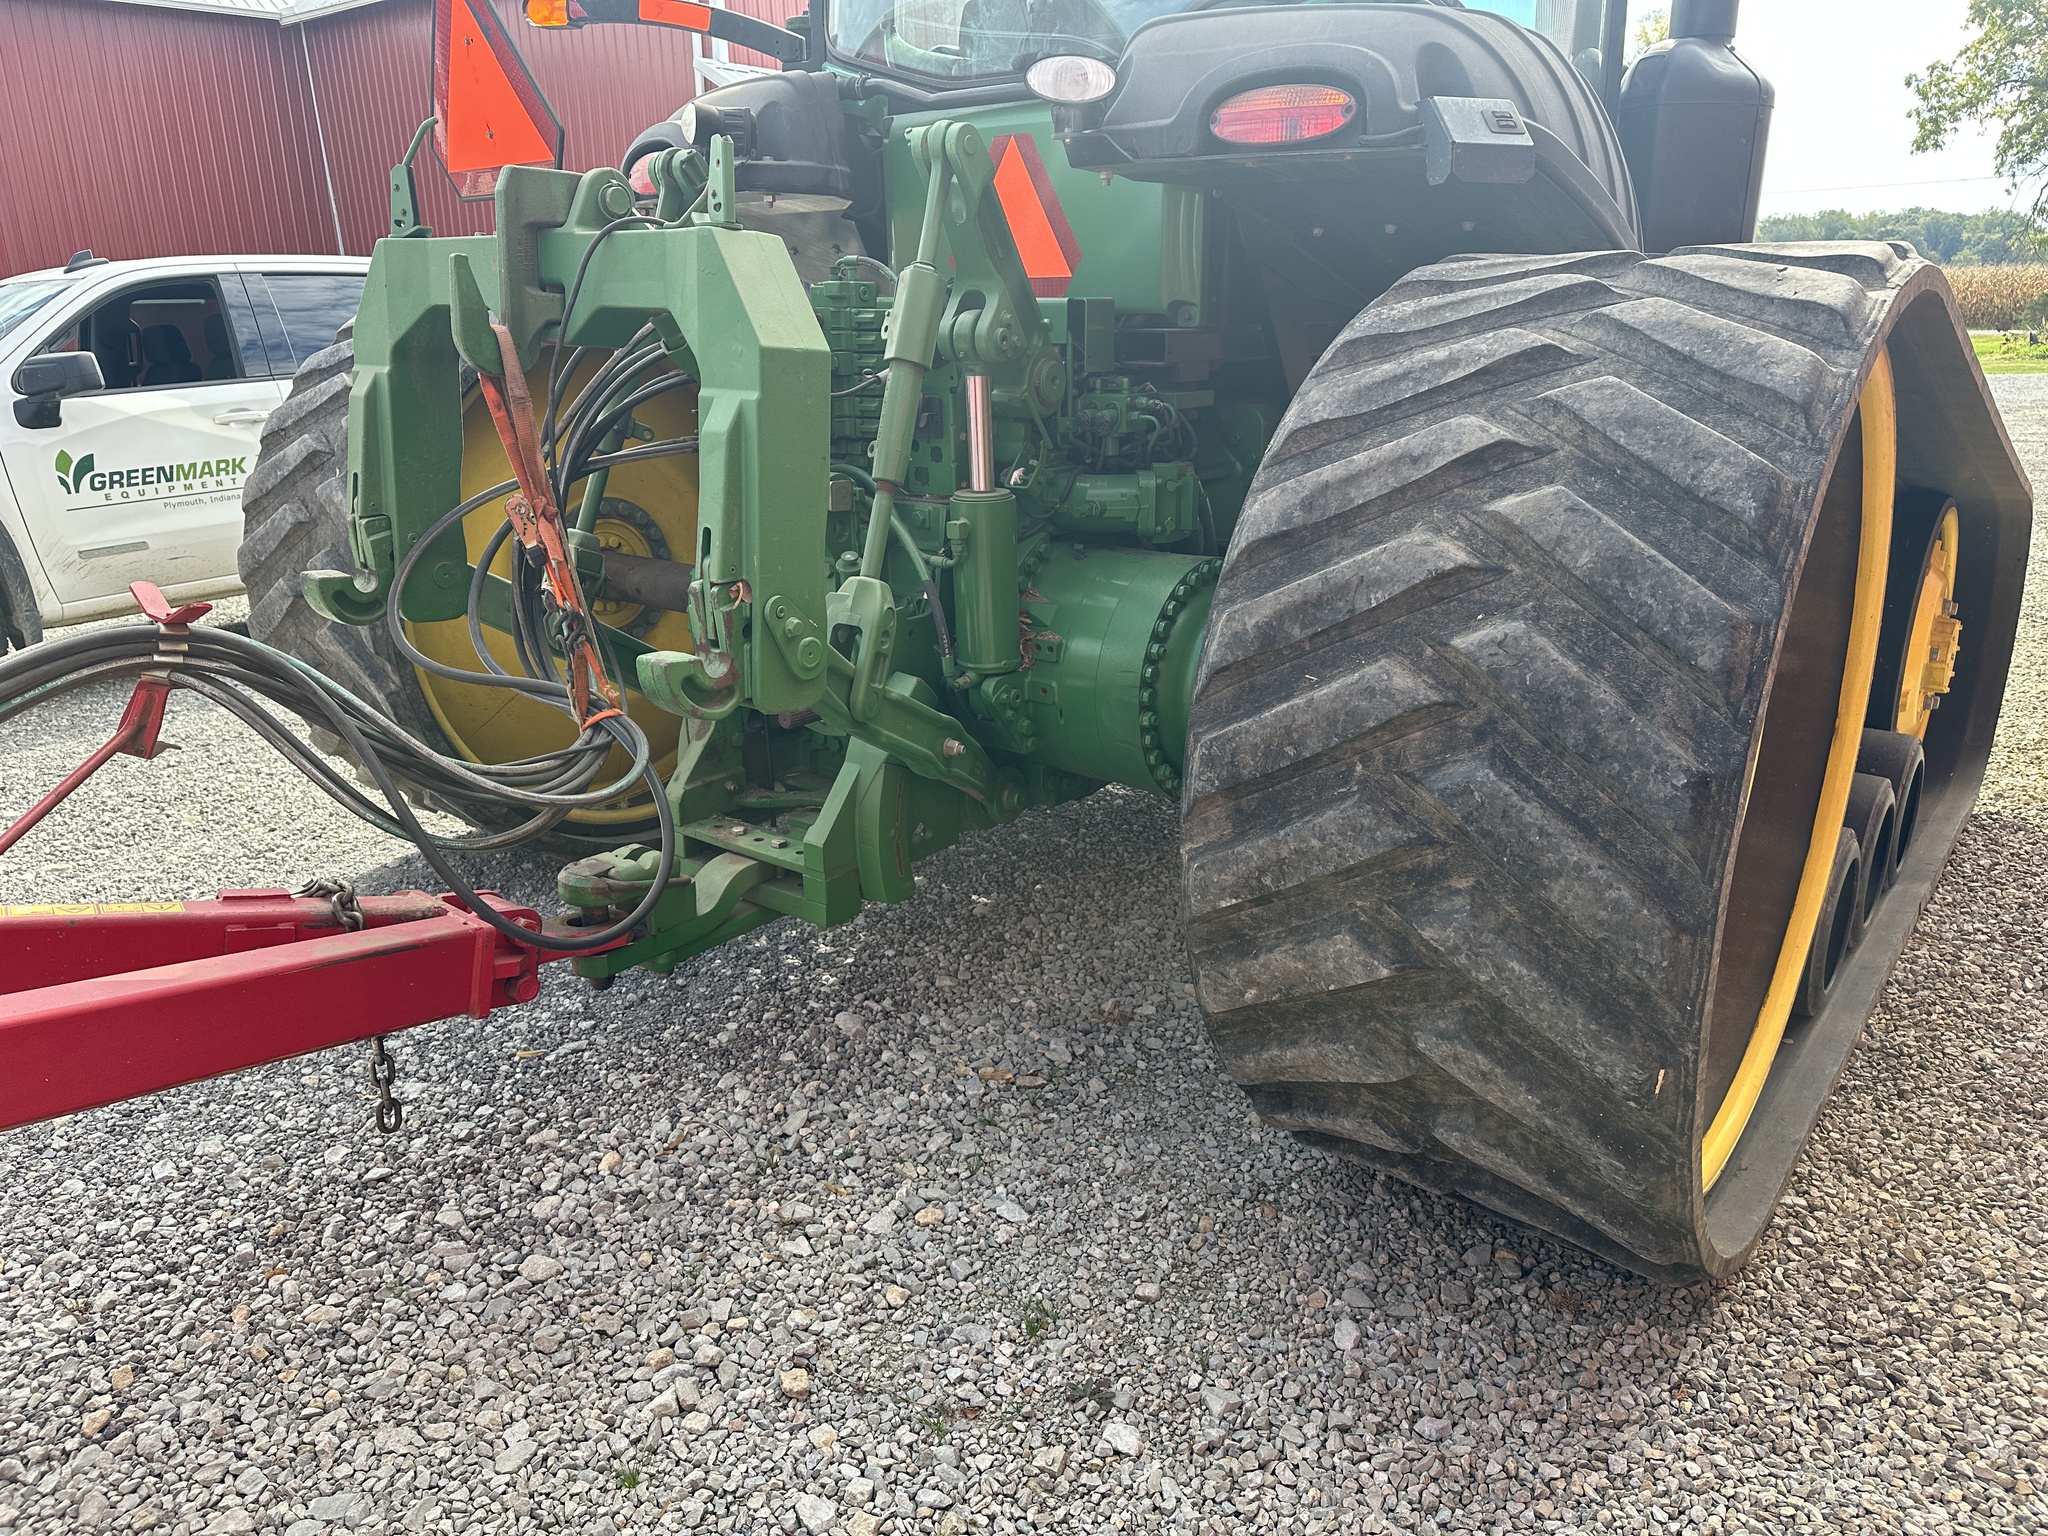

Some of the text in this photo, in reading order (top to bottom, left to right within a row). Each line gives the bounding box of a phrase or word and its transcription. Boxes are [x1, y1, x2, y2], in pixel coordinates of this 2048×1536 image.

[89, 456, 247, 492] GREENMARK
[104, 477, 237, 501] EQUIPMENT
[163, 493, 241, 510] Plymouth, Indiana
